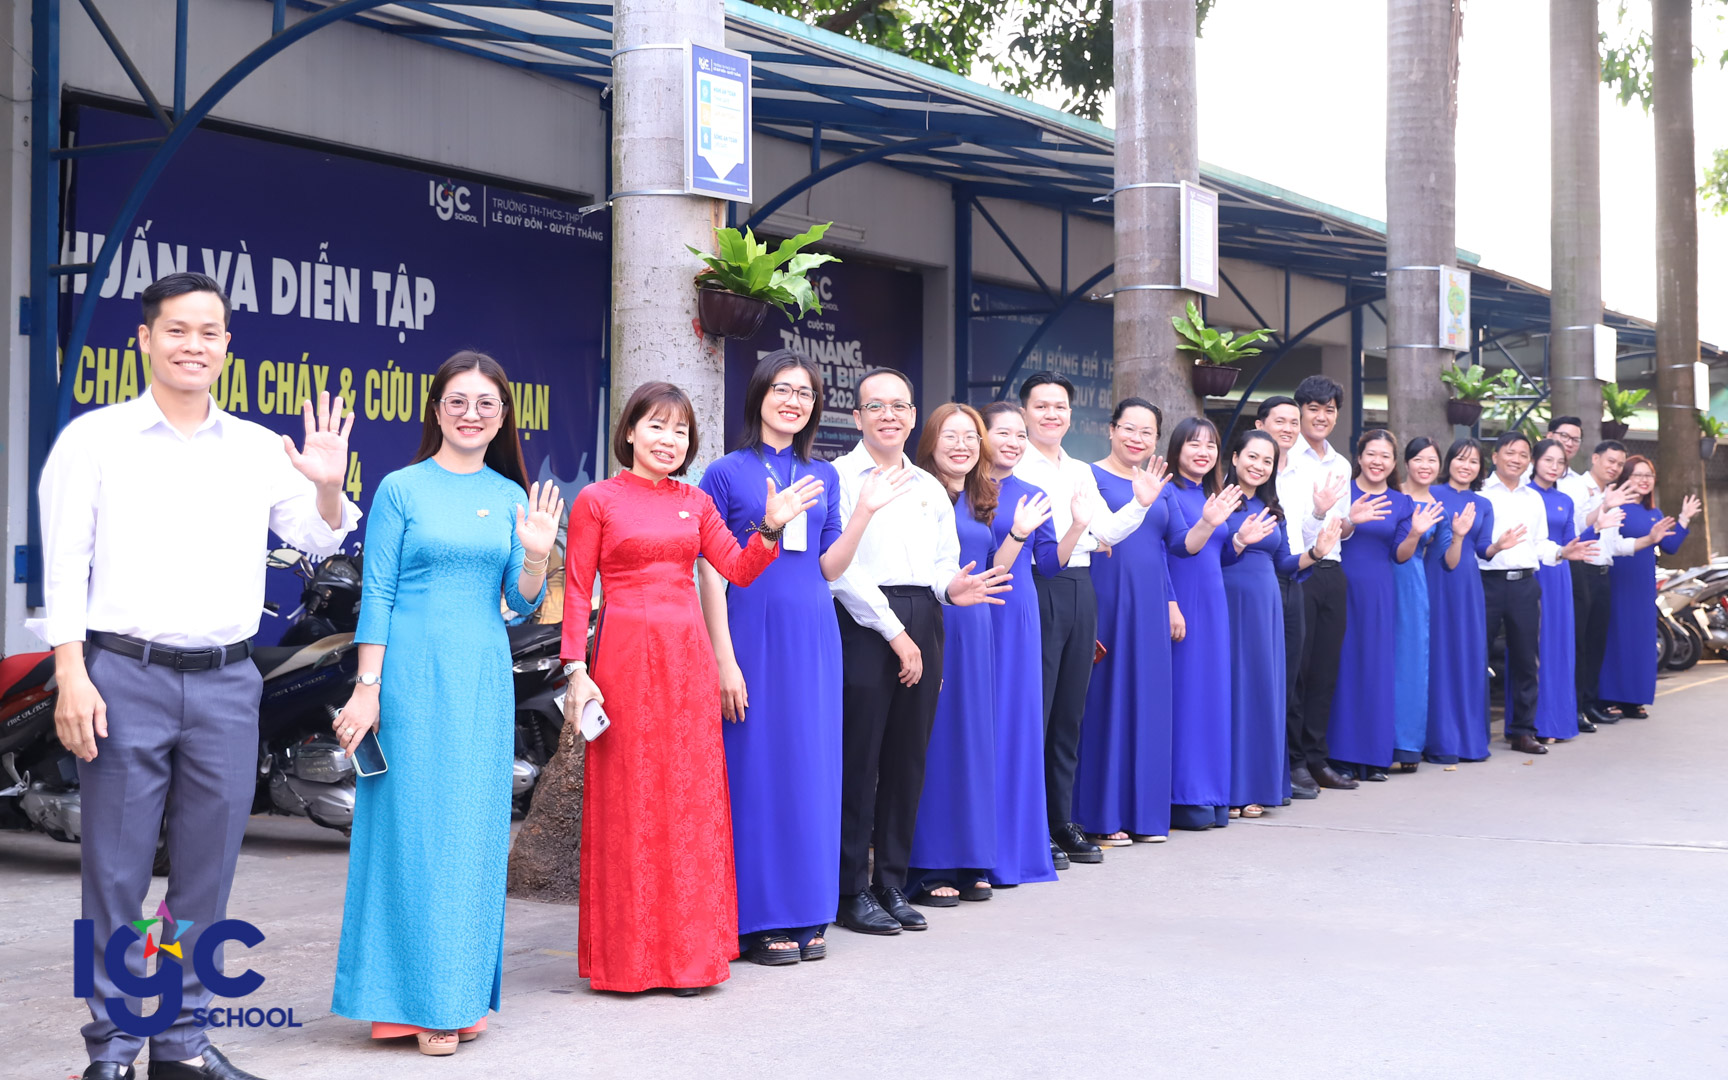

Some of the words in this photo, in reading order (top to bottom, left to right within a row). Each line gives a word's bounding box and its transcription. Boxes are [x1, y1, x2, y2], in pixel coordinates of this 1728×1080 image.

[454, 212, 479, 224] SCHOOL
[492, 211, 503, 223] LÊ
[504, 213, 522, 227] QUÝ
[524, 216, 543, 231] ĐÔN
[549, 222, 576, 237] QUYẾT
[201, 240, 259, 313] VÀ
[272, 241, 360, 324] DIỄN
[372, 263, 436, 344] TẬP
[258, 352, 329, 418] CHÁY
[337, 367, 357, 419] &
[365, 360, 413, 423] CỨU
[829, 387, 855, 410] 202
